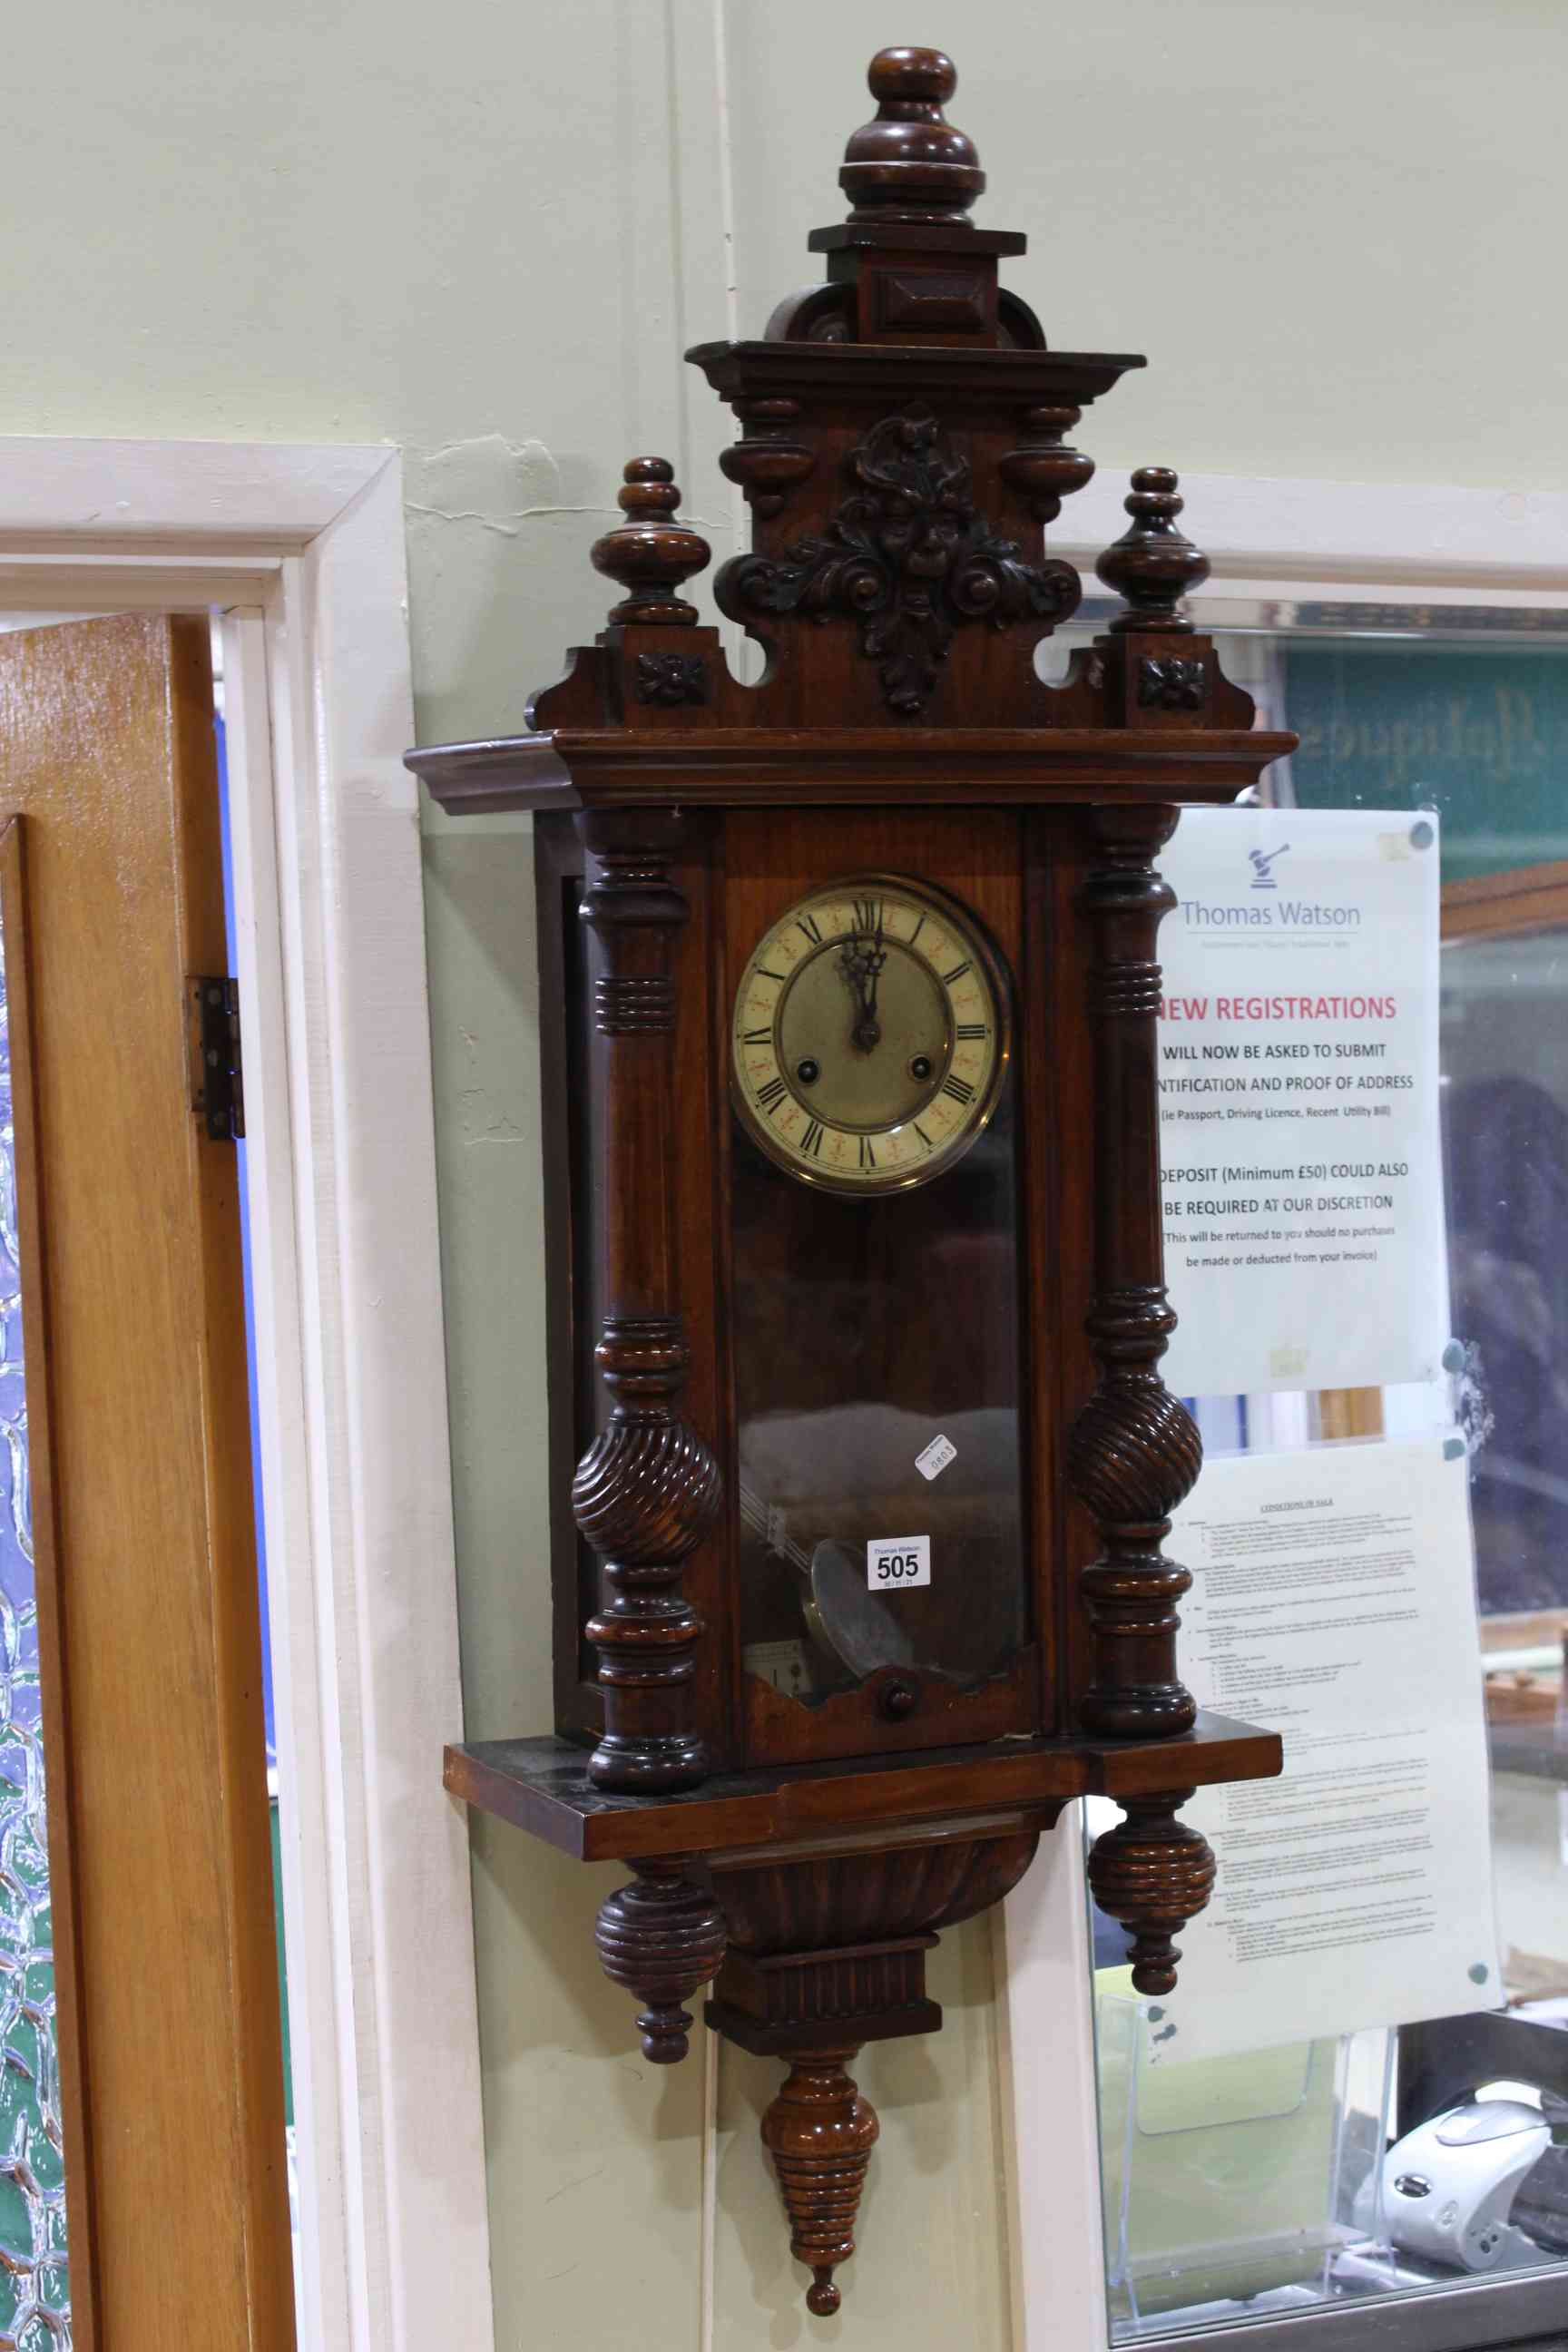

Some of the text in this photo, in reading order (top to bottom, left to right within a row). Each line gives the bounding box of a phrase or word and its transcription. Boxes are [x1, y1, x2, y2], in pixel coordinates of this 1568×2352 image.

[1181, 901, 1360, 925] Thomas Watson
[1217, 995, 1396, 1020] REGISTRATIONS
[1163, 1044, 1387, 1060] WILL NOW BE ASKED TO SUBMIT
[1157, 1074, 1414, 1093] NTIFICATION AND PROOF OF ADDRESS
[1161, 1110, 1175, 1121] (ie
[1178, 1109, 1224, 1122] Passport,
[1227, 1108, 1263, 1120] Driving
[1265, 1107, 1304, 1118] Licence,
[1307, 1106, 1338, 1117] Recent
[1343, 1105, 1371, 1118] Utility
[1161, 1162, 1408, 1183] DEPOSIT (Minimum £50) COULD ALSO
[1164, 1195, 1393, 1216] BE REQUIRED AT OUR DISCRETION
[1190, 1231, 1208, 1242] will
[1210, 1231, 1223, 1241] be
[1226, 1230, 1269, 1241] returned
[1271, 1230, 1282, 1240] to
[1284, 1230, 1302, 1240] you
[1305, 1227, 1336, 1239] should
[1338, 1229, 1350, 1237] no
[1186, 1256, 1199, 1267] be
[1201, 1256, 1230, 1266] made
[1232, 1257, 1244, 1265] or
[1246, 1254, 1291, 1265] deducted
[1294, 1252, 1317, 1263] from
[1319, 1252, 1340, 1263] your
[877, 1554, 919, 1579] 505
